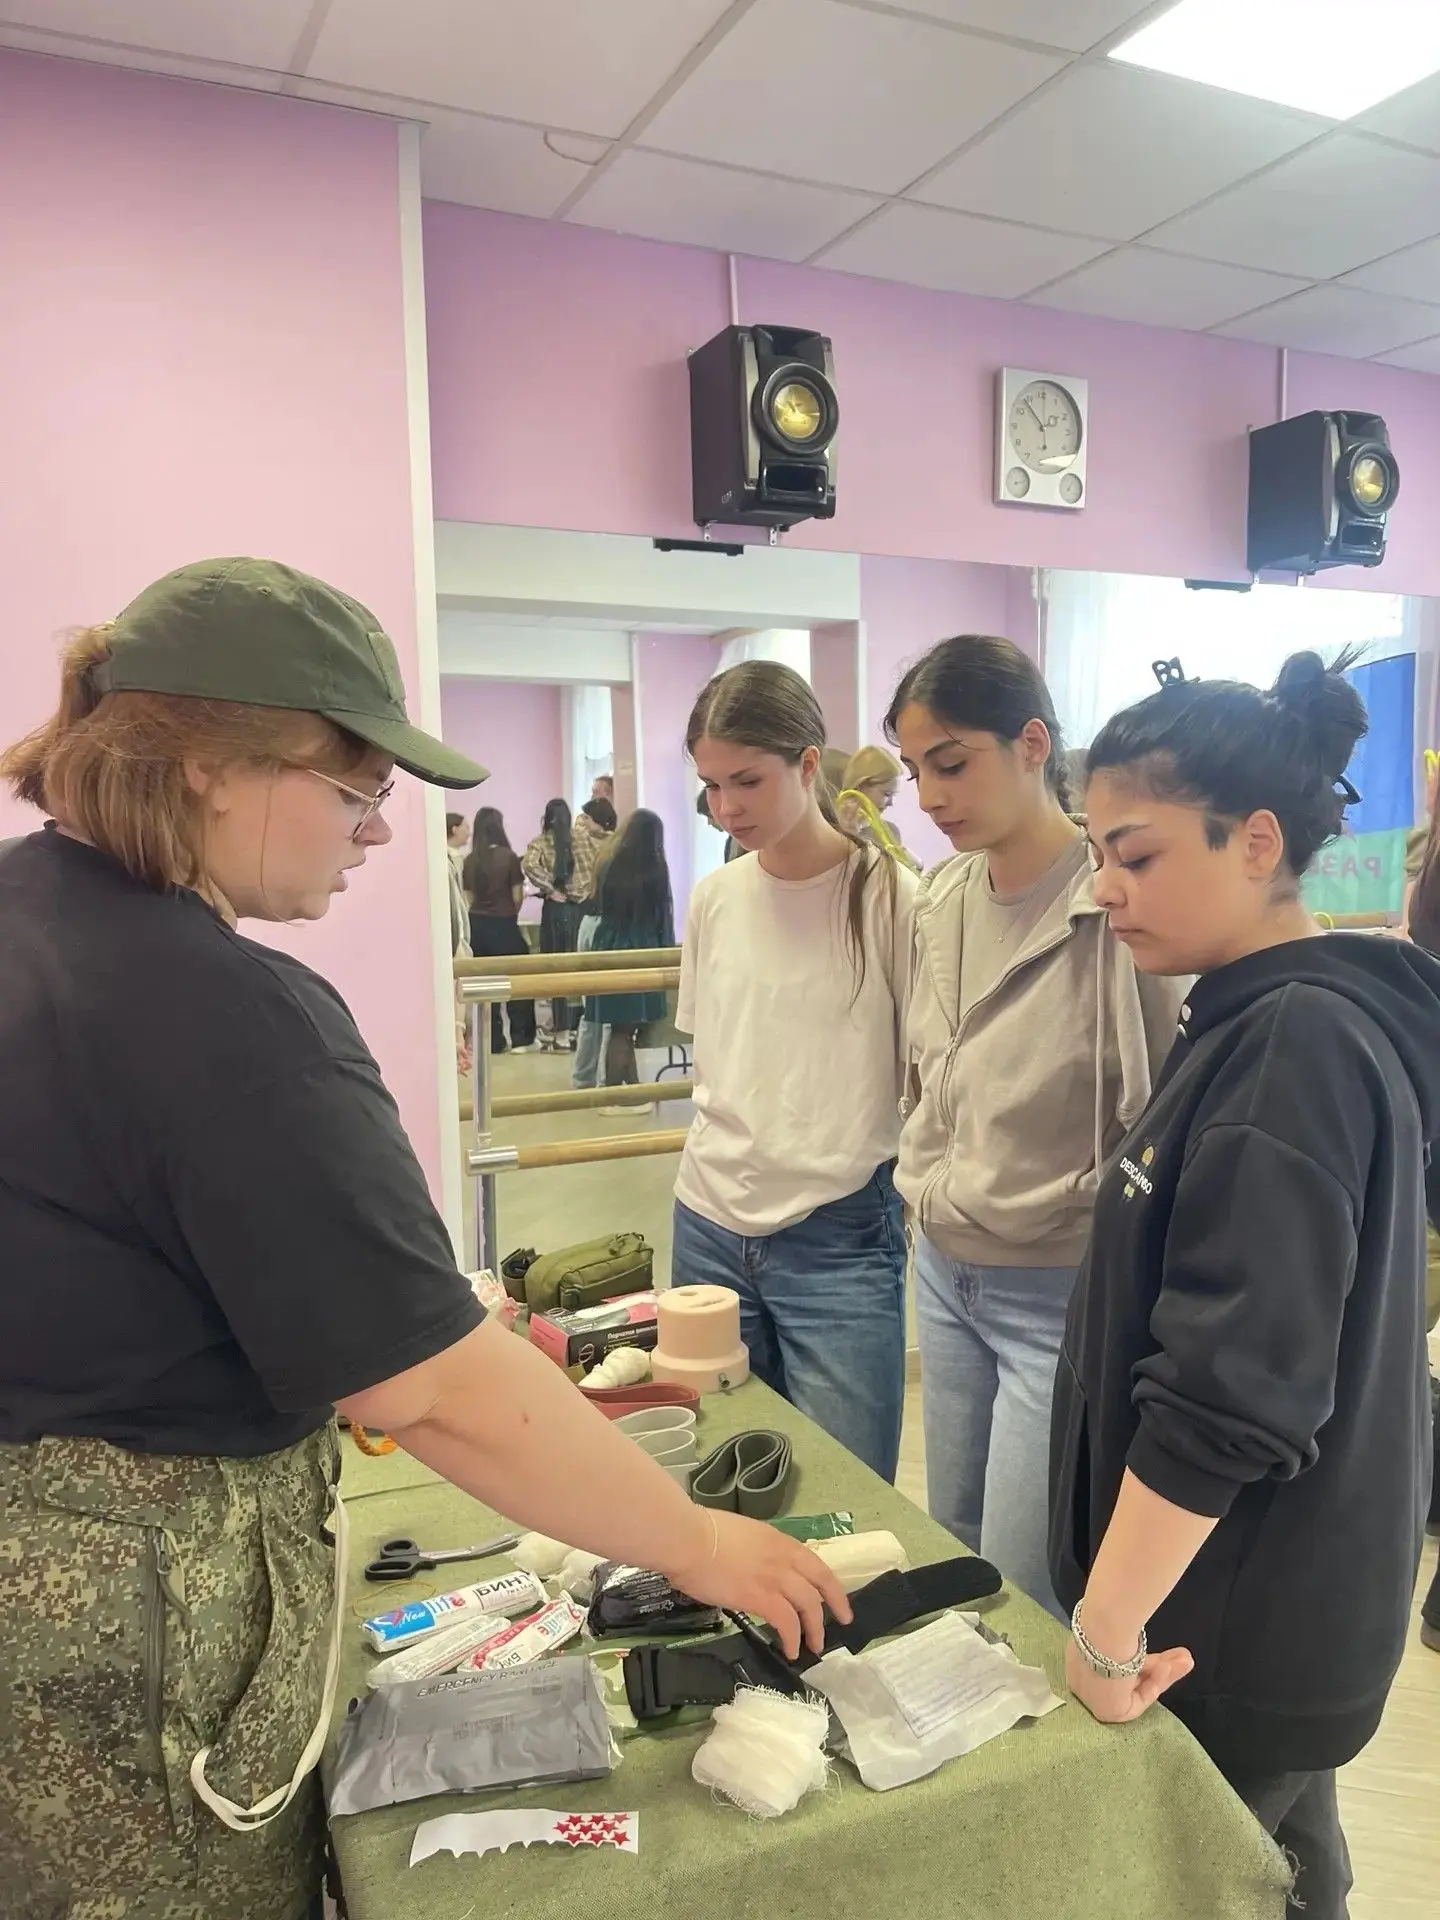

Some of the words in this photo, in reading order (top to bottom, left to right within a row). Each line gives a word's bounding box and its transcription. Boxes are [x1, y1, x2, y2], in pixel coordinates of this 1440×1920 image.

[1120, 1157, 1153, 1195] DESCANSO
[477, 1573, 531, 1596] БИНТ
[401, 1609, 426, 1627] New
[498, 1652, 521, 1669] БИН
[416, 1673, 496, 1698] EMERGENCY
